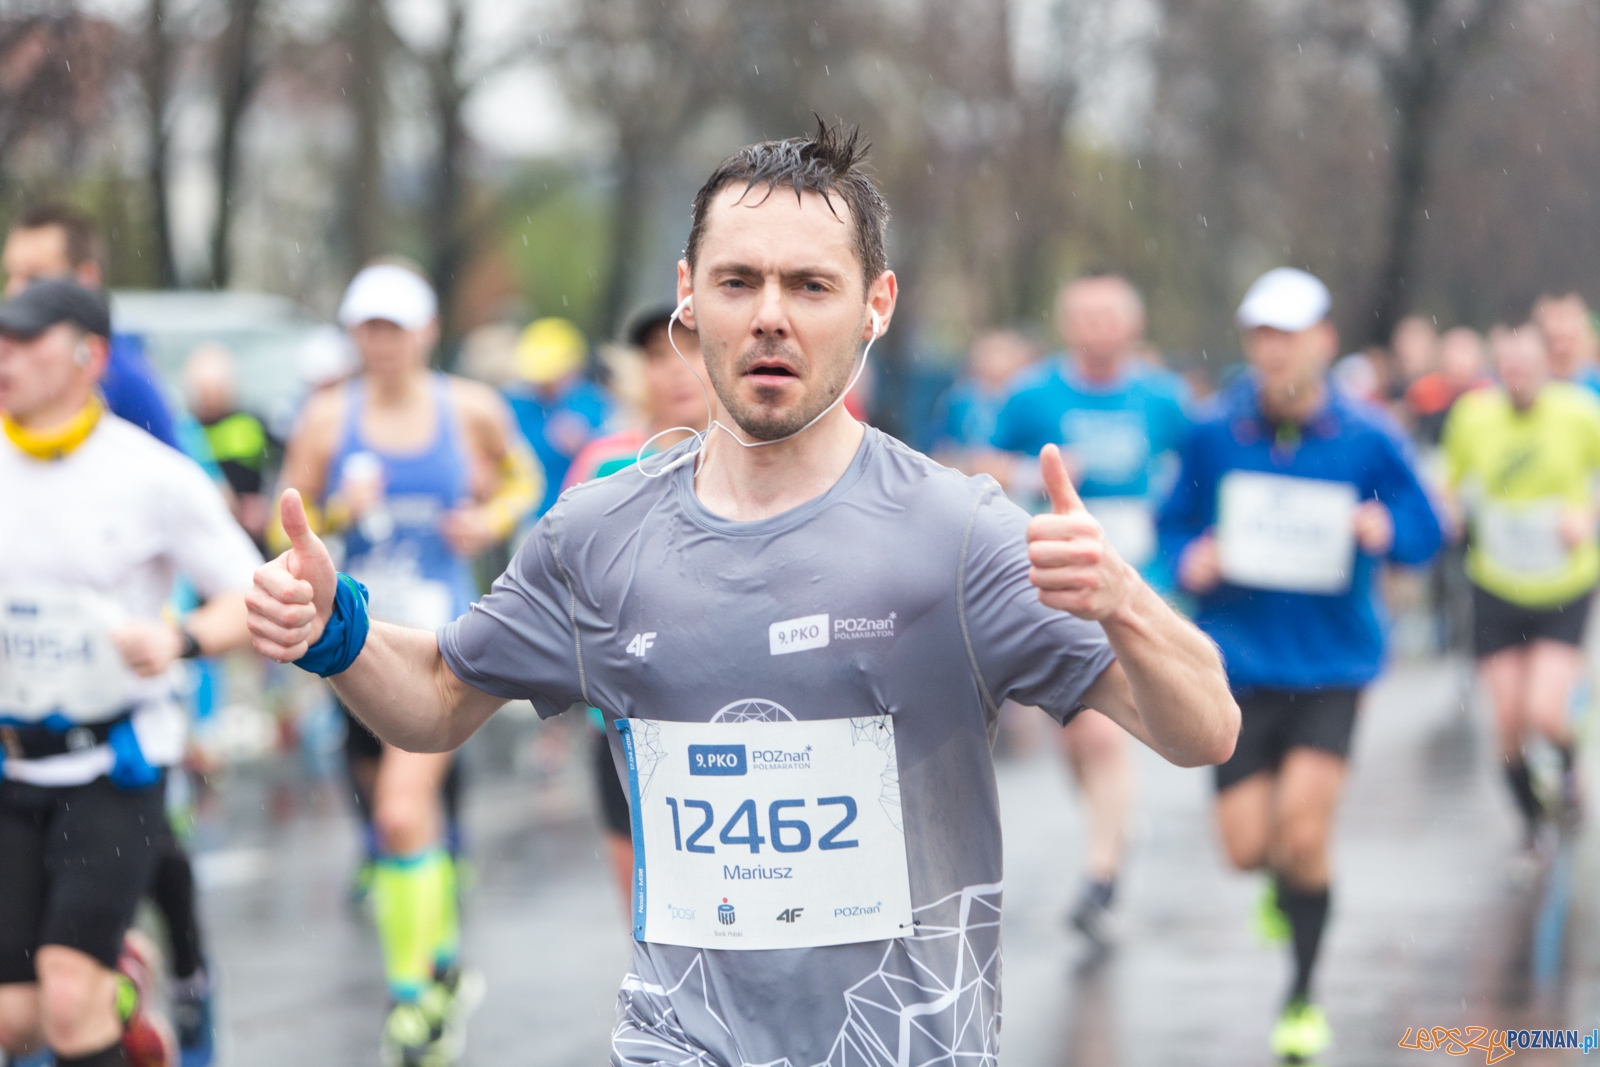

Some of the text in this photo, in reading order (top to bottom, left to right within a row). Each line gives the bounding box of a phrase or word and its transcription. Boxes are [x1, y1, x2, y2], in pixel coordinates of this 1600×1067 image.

[626, 632, 657, 657] 4F
[665, 795, 859, 854] 12462
[723, 865, 793, 880] Mariusz
[776, 907, 804, 923] 4F
